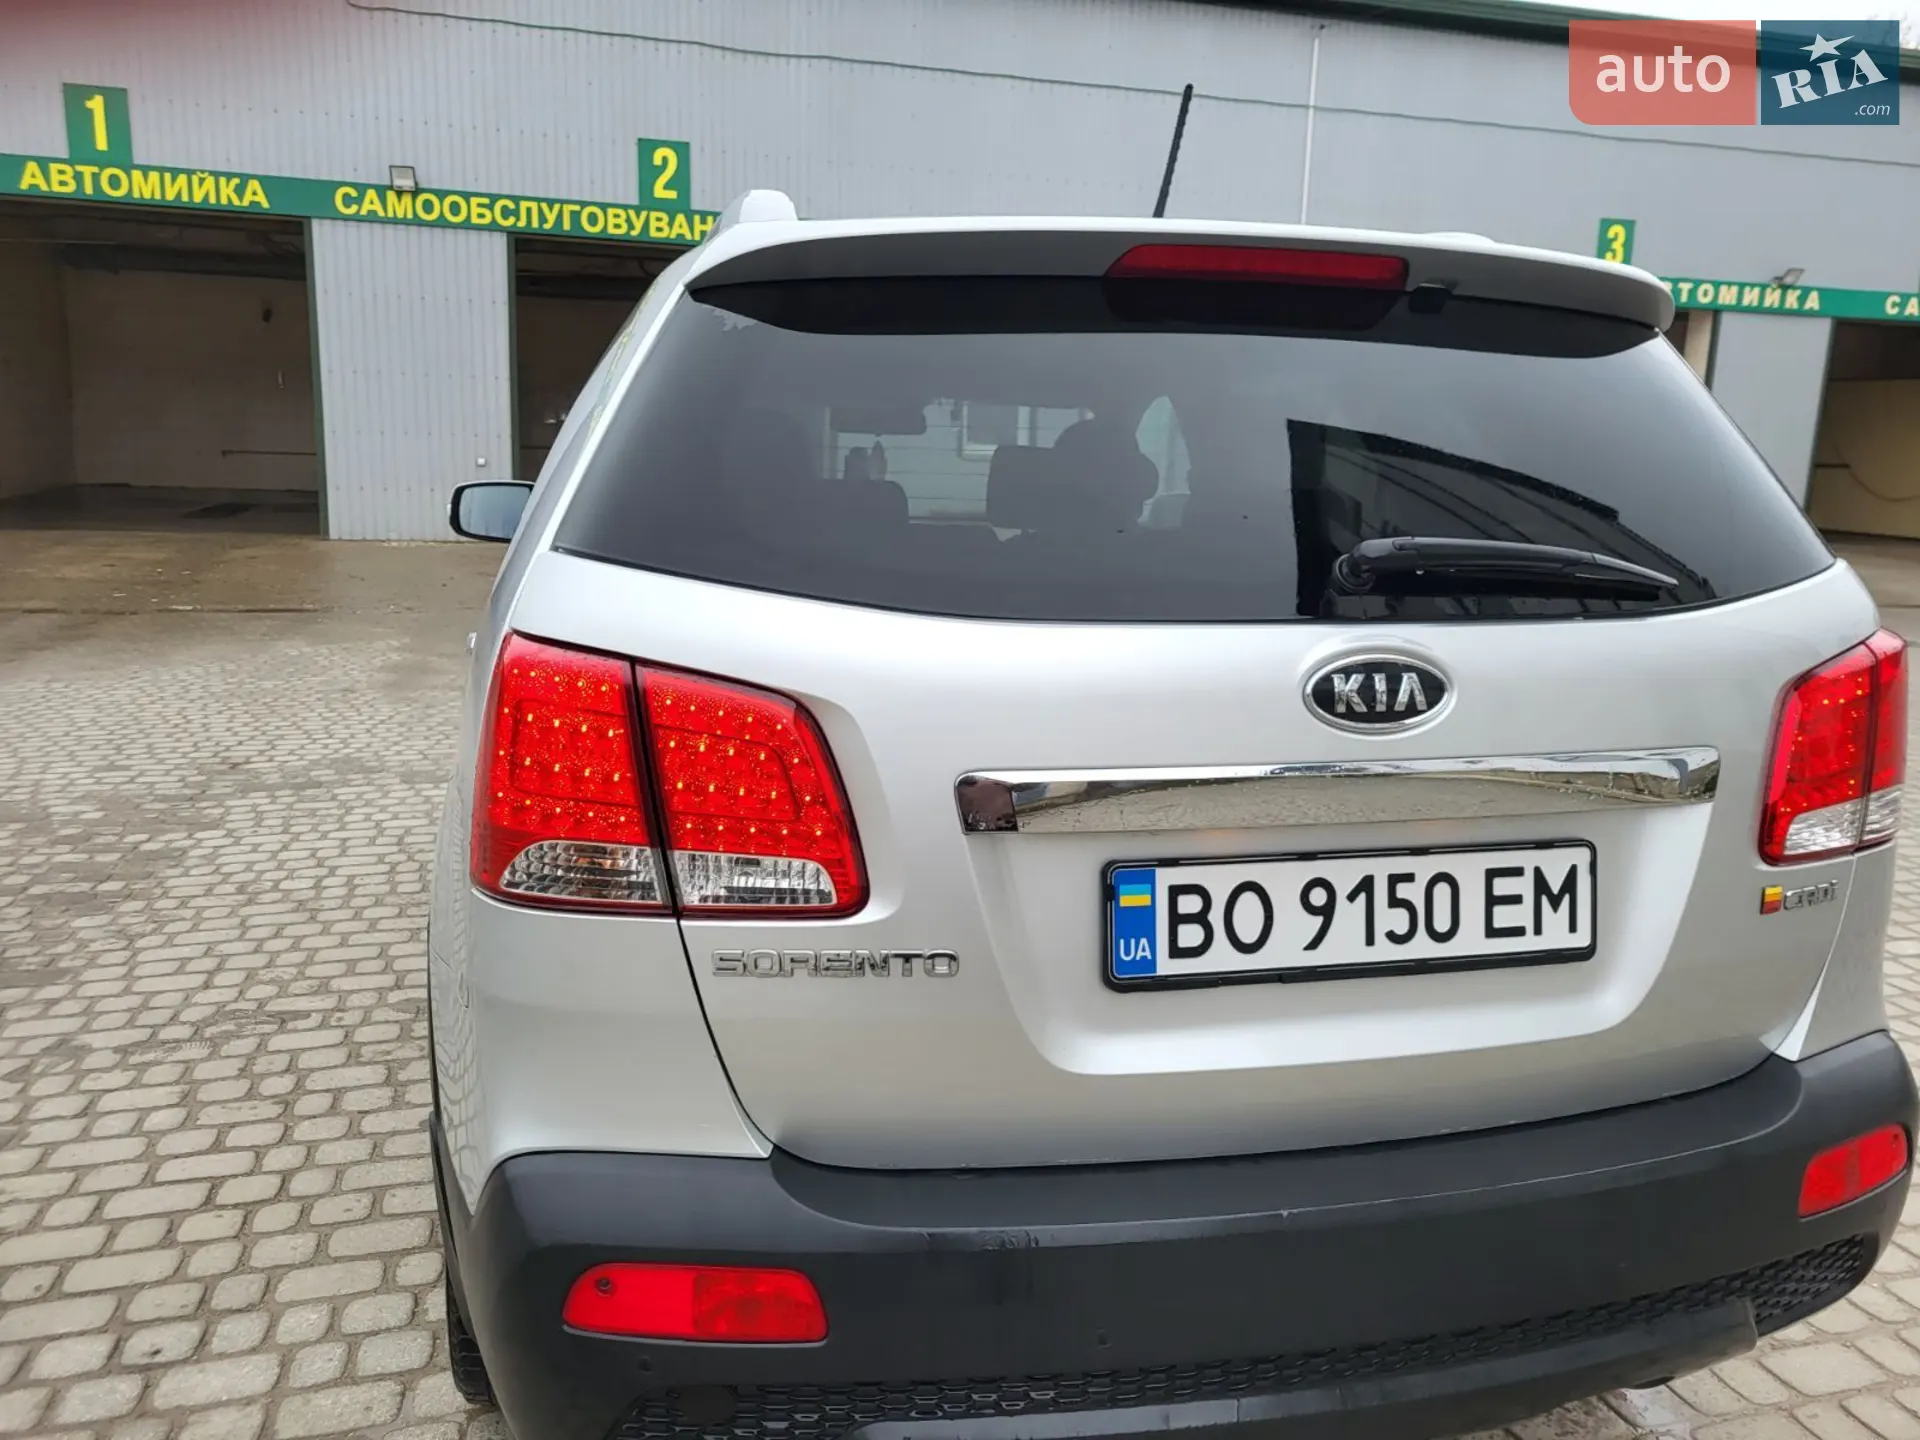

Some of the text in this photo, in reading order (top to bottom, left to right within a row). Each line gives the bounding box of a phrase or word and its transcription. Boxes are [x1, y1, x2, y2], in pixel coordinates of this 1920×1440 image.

[84, 94, 109, 152] 1
[651, 146, 679, 200] 2
[18, 160, 715, 241] АВТОМИЙКА САМООБСЛУГОВУВАН
[1605, 223, 1626, 264] 3
[1662, 280, 1820, 311] ТОМИЙКА
[1331, 672, 1428, 714] KIA
[1118, 863, 1579, 962] UA BO 9150 EM
[712, 948, 960, 978] SORENTO
